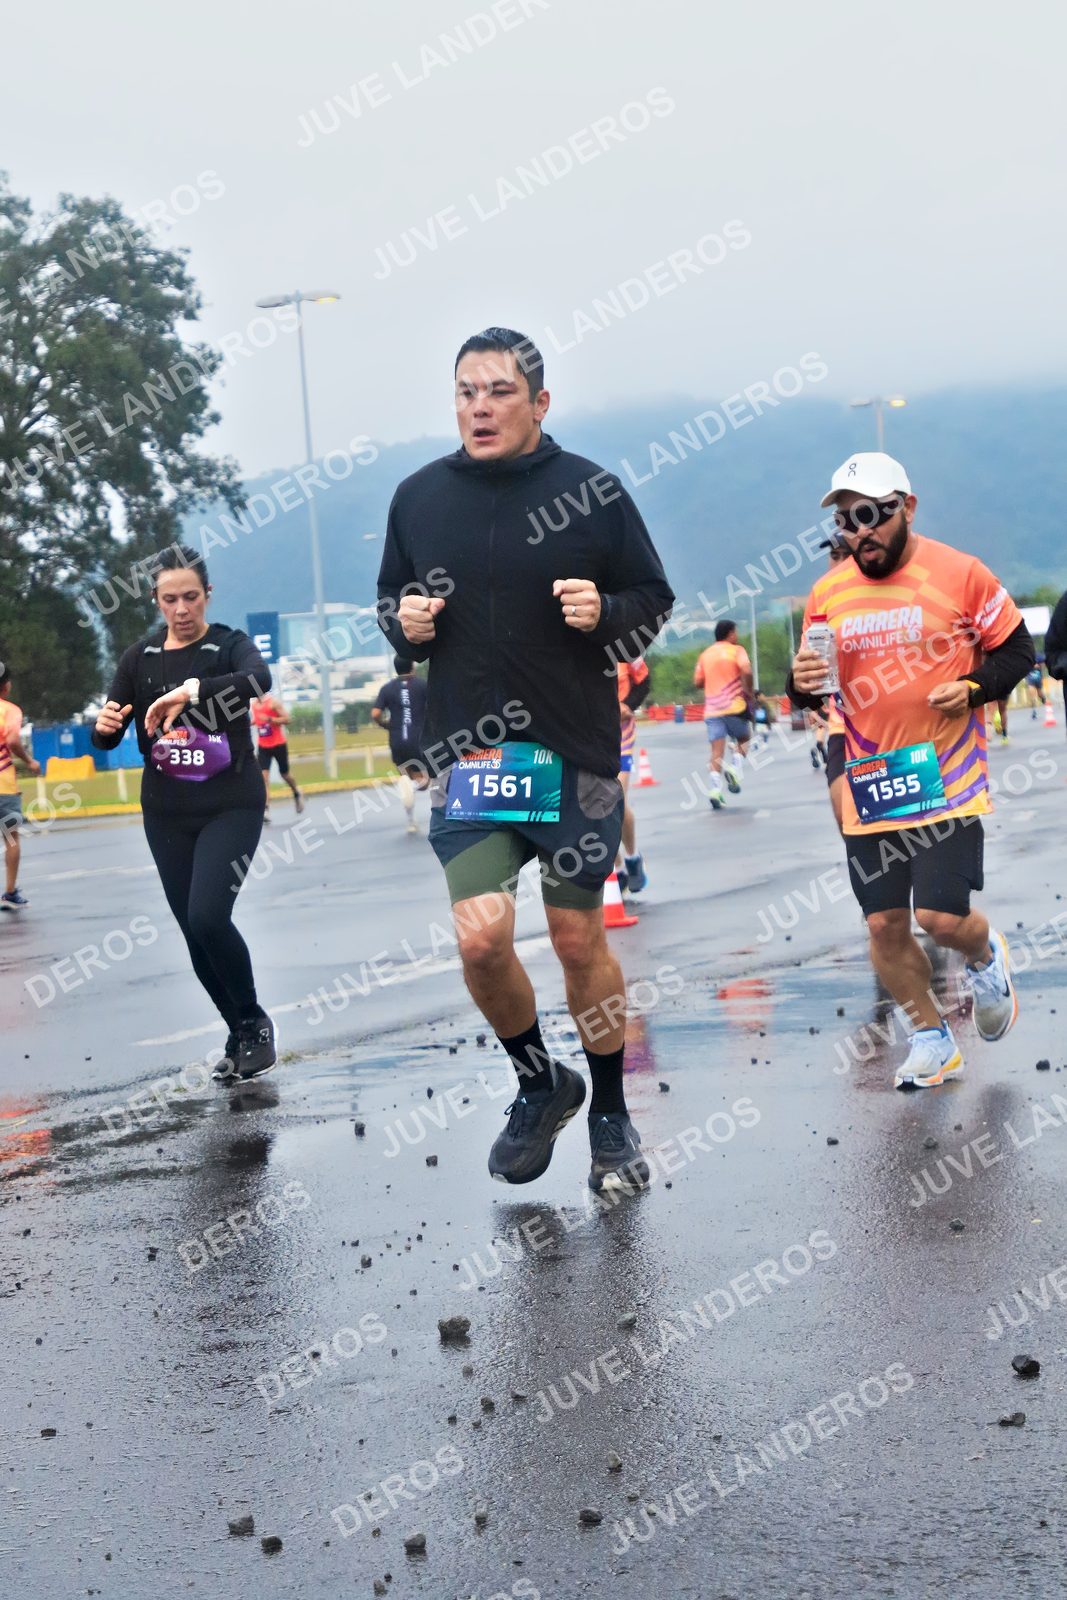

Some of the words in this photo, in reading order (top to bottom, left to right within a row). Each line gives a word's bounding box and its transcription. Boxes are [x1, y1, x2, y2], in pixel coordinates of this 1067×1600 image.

[841, 605, 922, 638] CARRERA
[170, 748, 205, 766] 338
[533, 749, 554, 764] 10K
[910, 748, 928, 764] 10K
[851, 759, 886, 777] CARRERA
[468, 774, 532, 798] 1561
[867, 773, 921, 802] 1555
